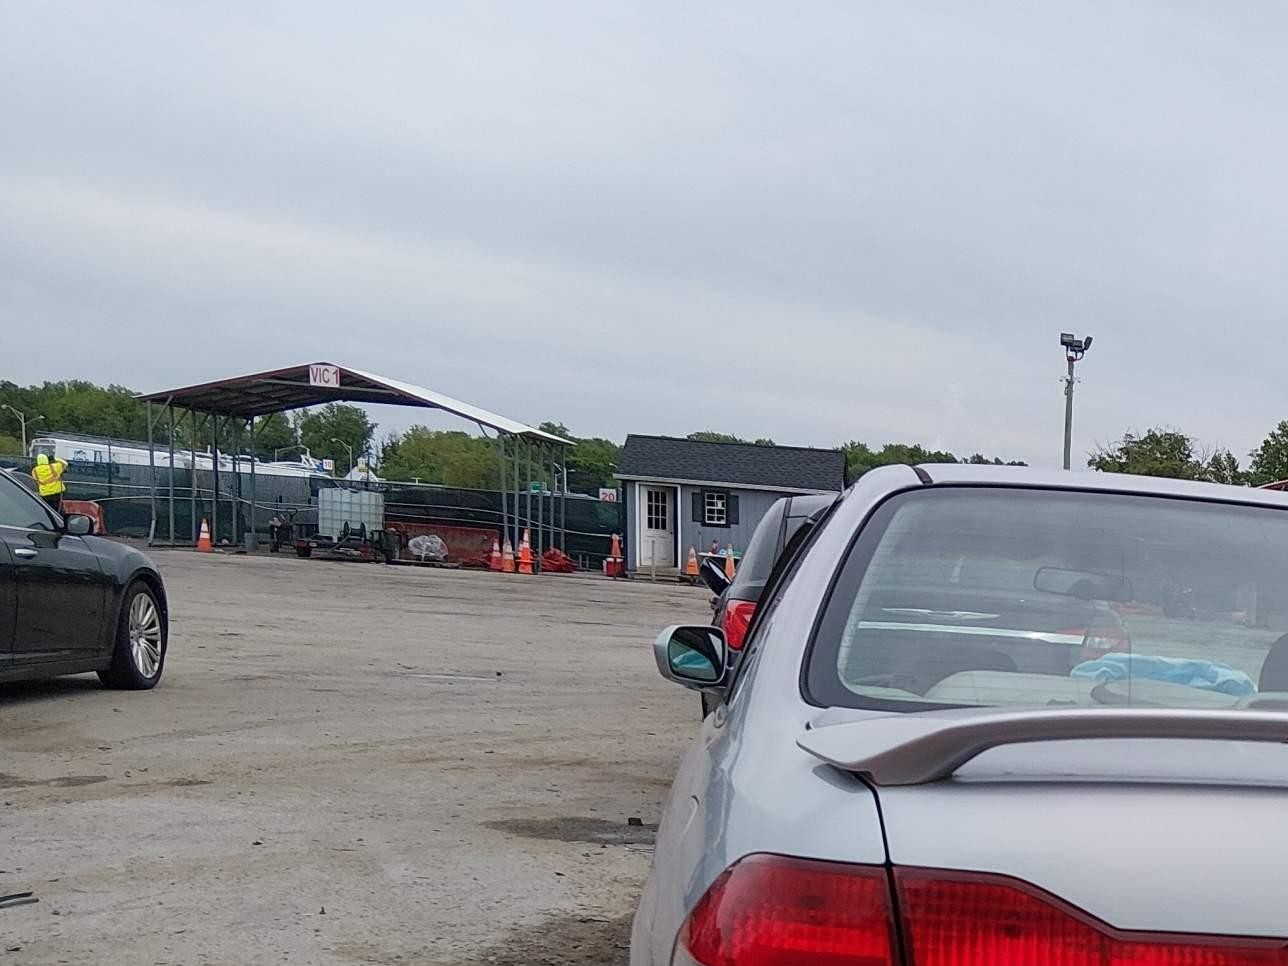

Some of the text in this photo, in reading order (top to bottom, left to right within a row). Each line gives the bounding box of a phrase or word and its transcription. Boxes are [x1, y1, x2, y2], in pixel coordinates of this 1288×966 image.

[310, 367, 339, 385] VIC 1
[601, 492, 615, 502] 20
